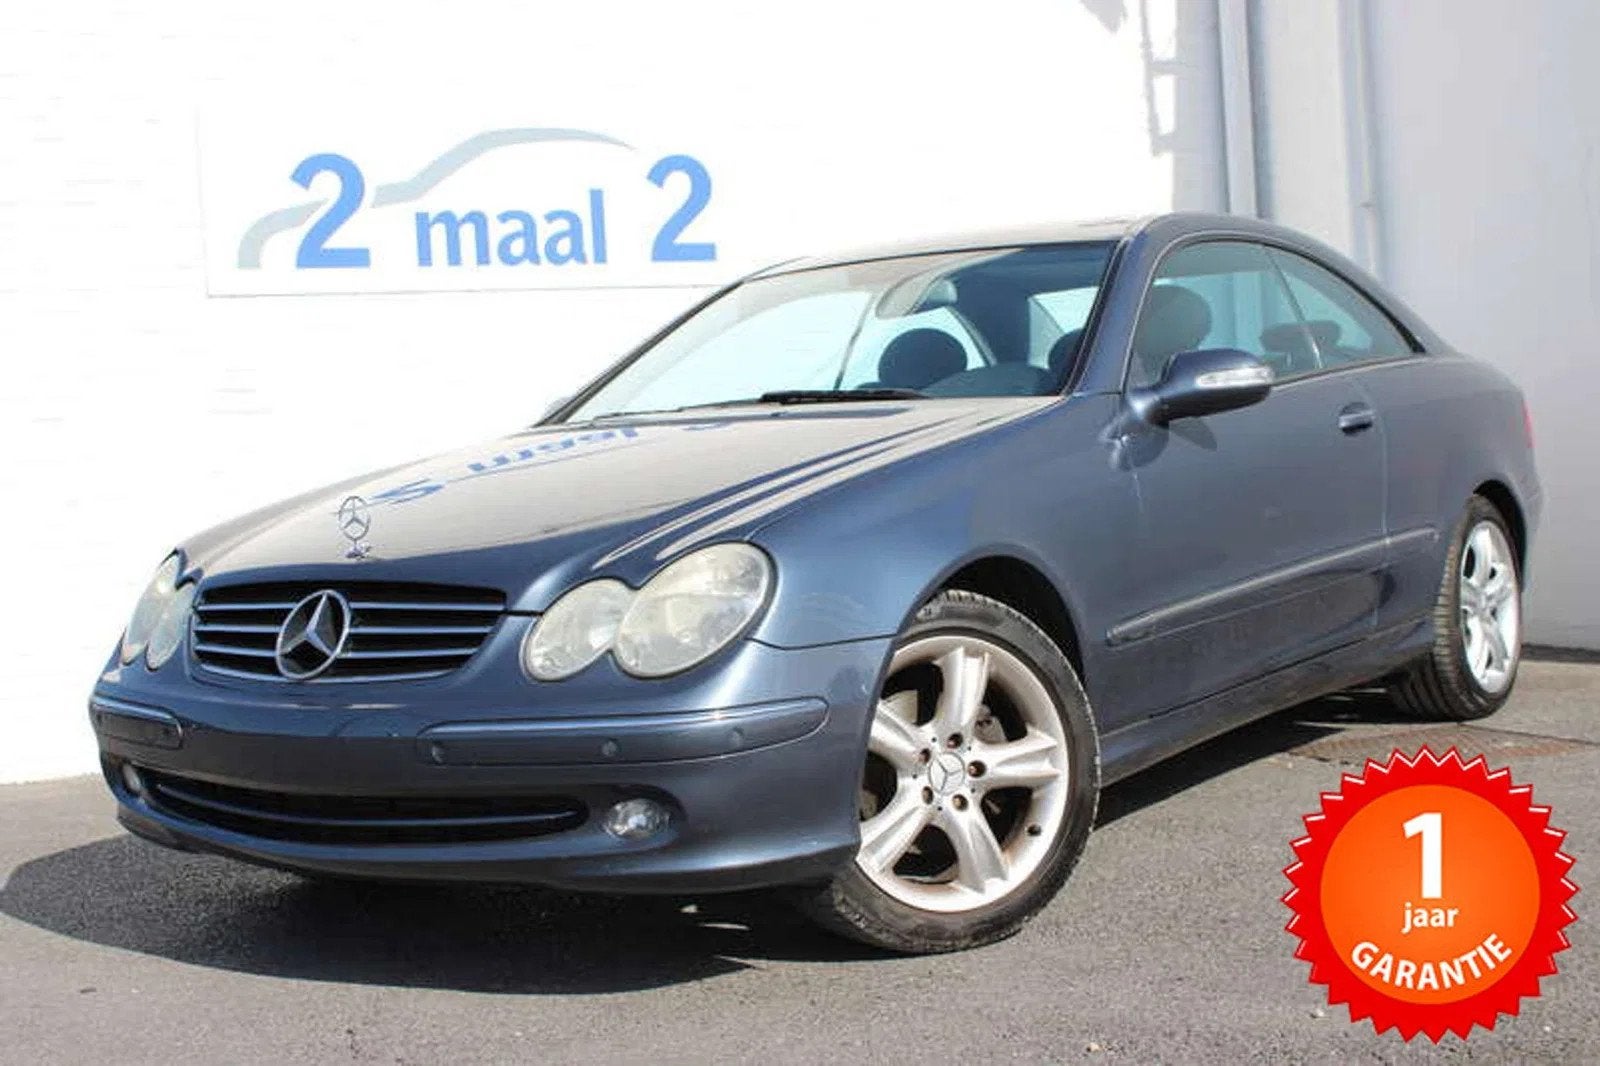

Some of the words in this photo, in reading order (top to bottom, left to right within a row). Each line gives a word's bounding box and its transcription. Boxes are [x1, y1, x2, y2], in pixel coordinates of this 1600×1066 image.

[290, 153, 370, 268] 2
[415, 189, 607, 267] maal
[646, 154, 717, 262] 2
